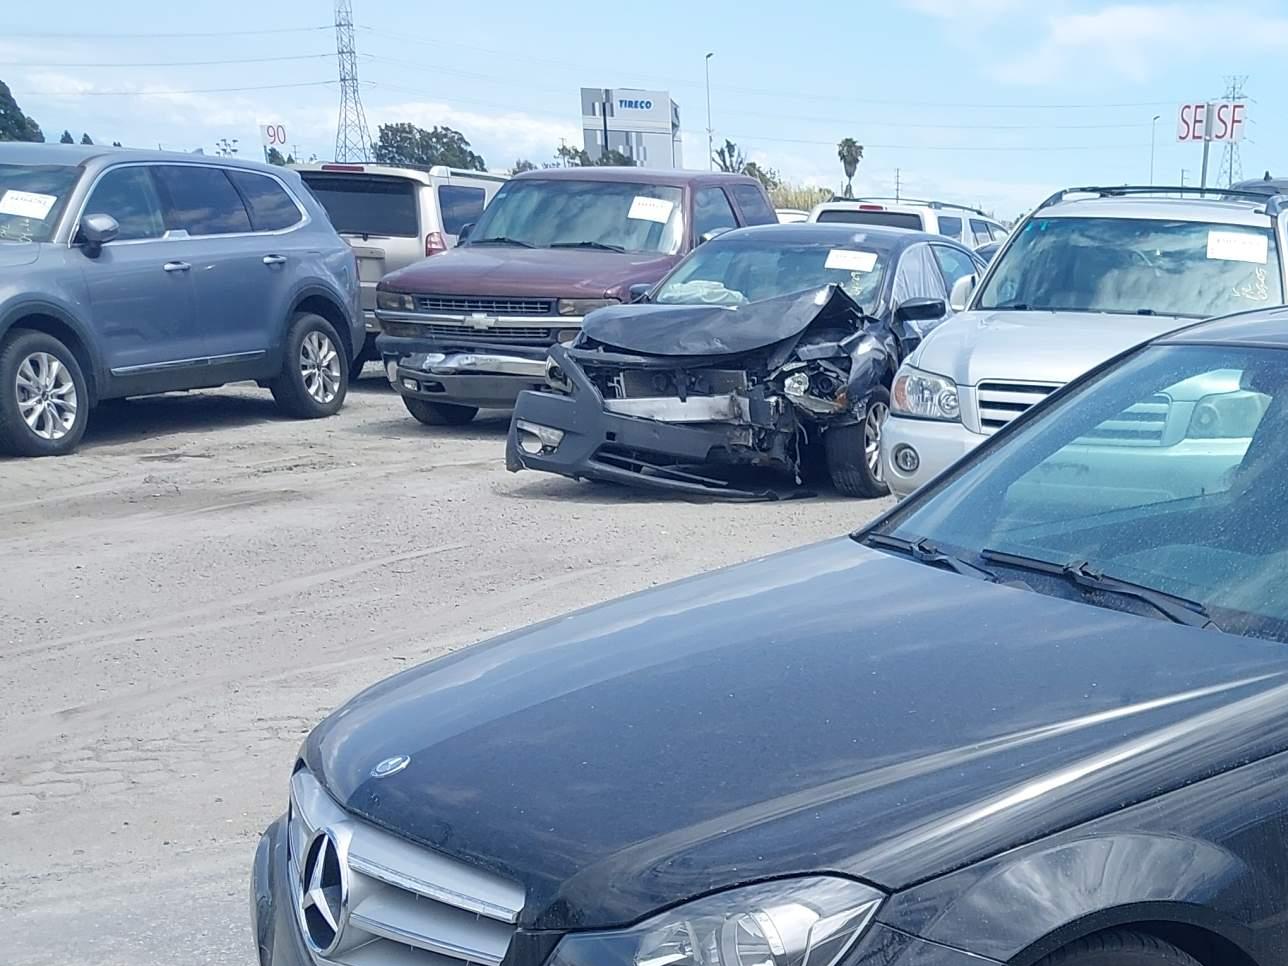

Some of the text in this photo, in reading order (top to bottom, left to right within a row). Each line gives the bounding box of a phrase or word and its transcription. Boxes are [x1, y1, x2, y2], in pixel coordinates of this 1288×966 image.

[617, 98, 652, 110] TIRECO
[266, 124, 287, 145] 90
[1178, 104, 1206, 140] SE
[1215, 104, 1245, 139] SF
